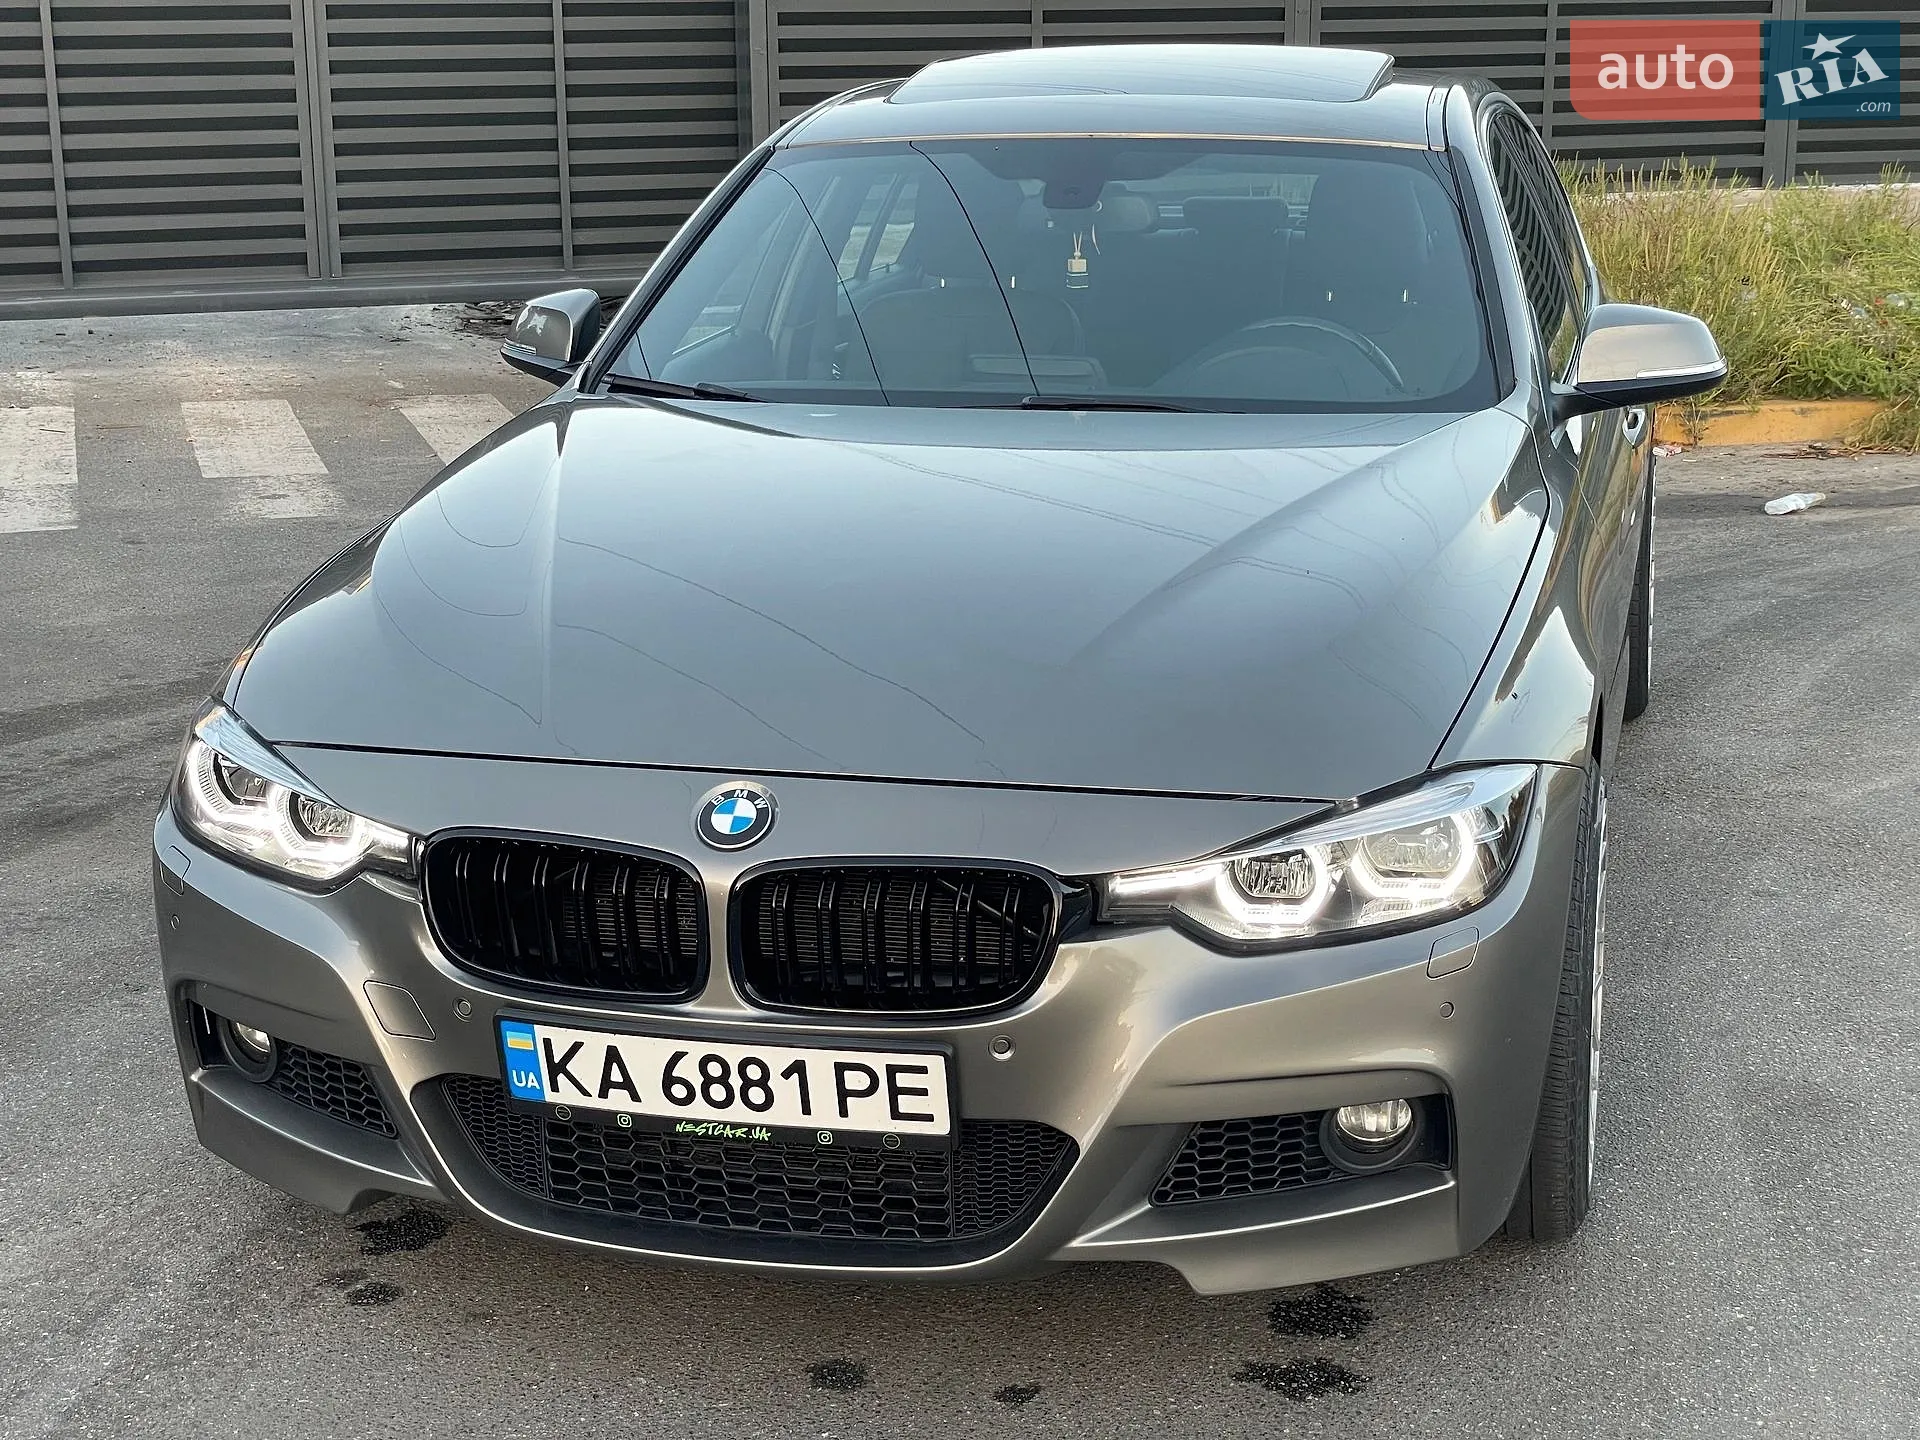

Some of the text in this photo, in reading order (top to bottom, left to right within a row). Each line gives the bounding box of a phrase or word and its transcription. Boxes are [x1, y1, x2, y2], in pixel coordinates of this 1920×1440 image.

[711, 789, 768, 809] BMW
[511, 1069, 541, 1090] UA
[542, 1037, 935, 1123] KA 6881 PE
[675, 1120, 772, 1141] NESTCAR.UA
